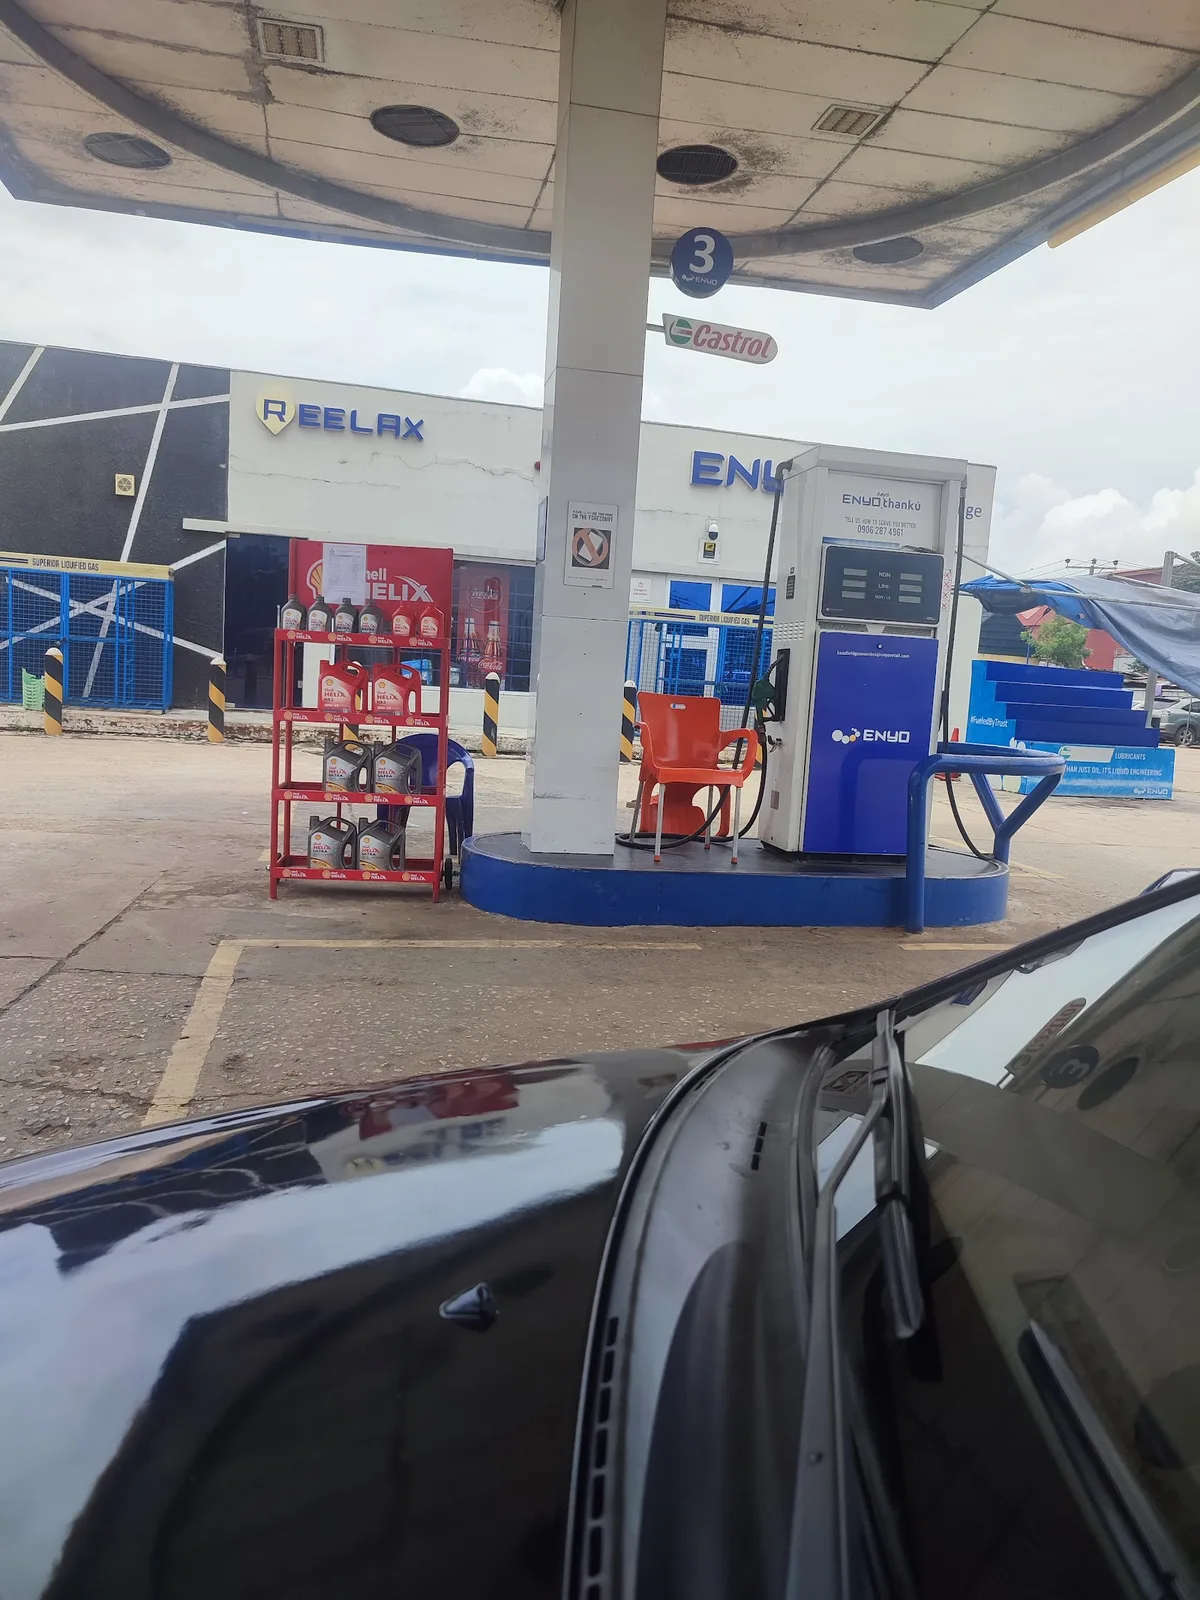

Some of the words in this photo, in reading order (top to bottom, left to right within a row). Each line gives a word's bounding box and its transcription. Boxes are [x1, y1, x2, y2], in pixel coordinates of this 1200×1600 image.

[689, 234, 716, 274] 3
[695, 276, 718, 286] ENYO
[693, 324, 772, 359] Castrol
[262, 398, 424, 442] REELAX
[842, 493, 881, 507] ENYO
[857, 524, 874, 535] 0906
[875, 526, 887, 536] 287
[888, 527, 904, 537] 4961
[32, 557, 60, 568] SUPERIOR
[61, 560, 87, 570] LIQUIFIED
[87, 562, 99, 572] GAS
[698, 613, 720, 623] SUPERIOR
[970, 715, 1008, 728] #FueledByTrust
[862, 729, 910, 743] ENYO
[1114, 752, 1146, 761] LUBRICANTS
[1078, 766, 1091, 774] JUST
[1130, 768, 1162, 777] ENGINEERING
